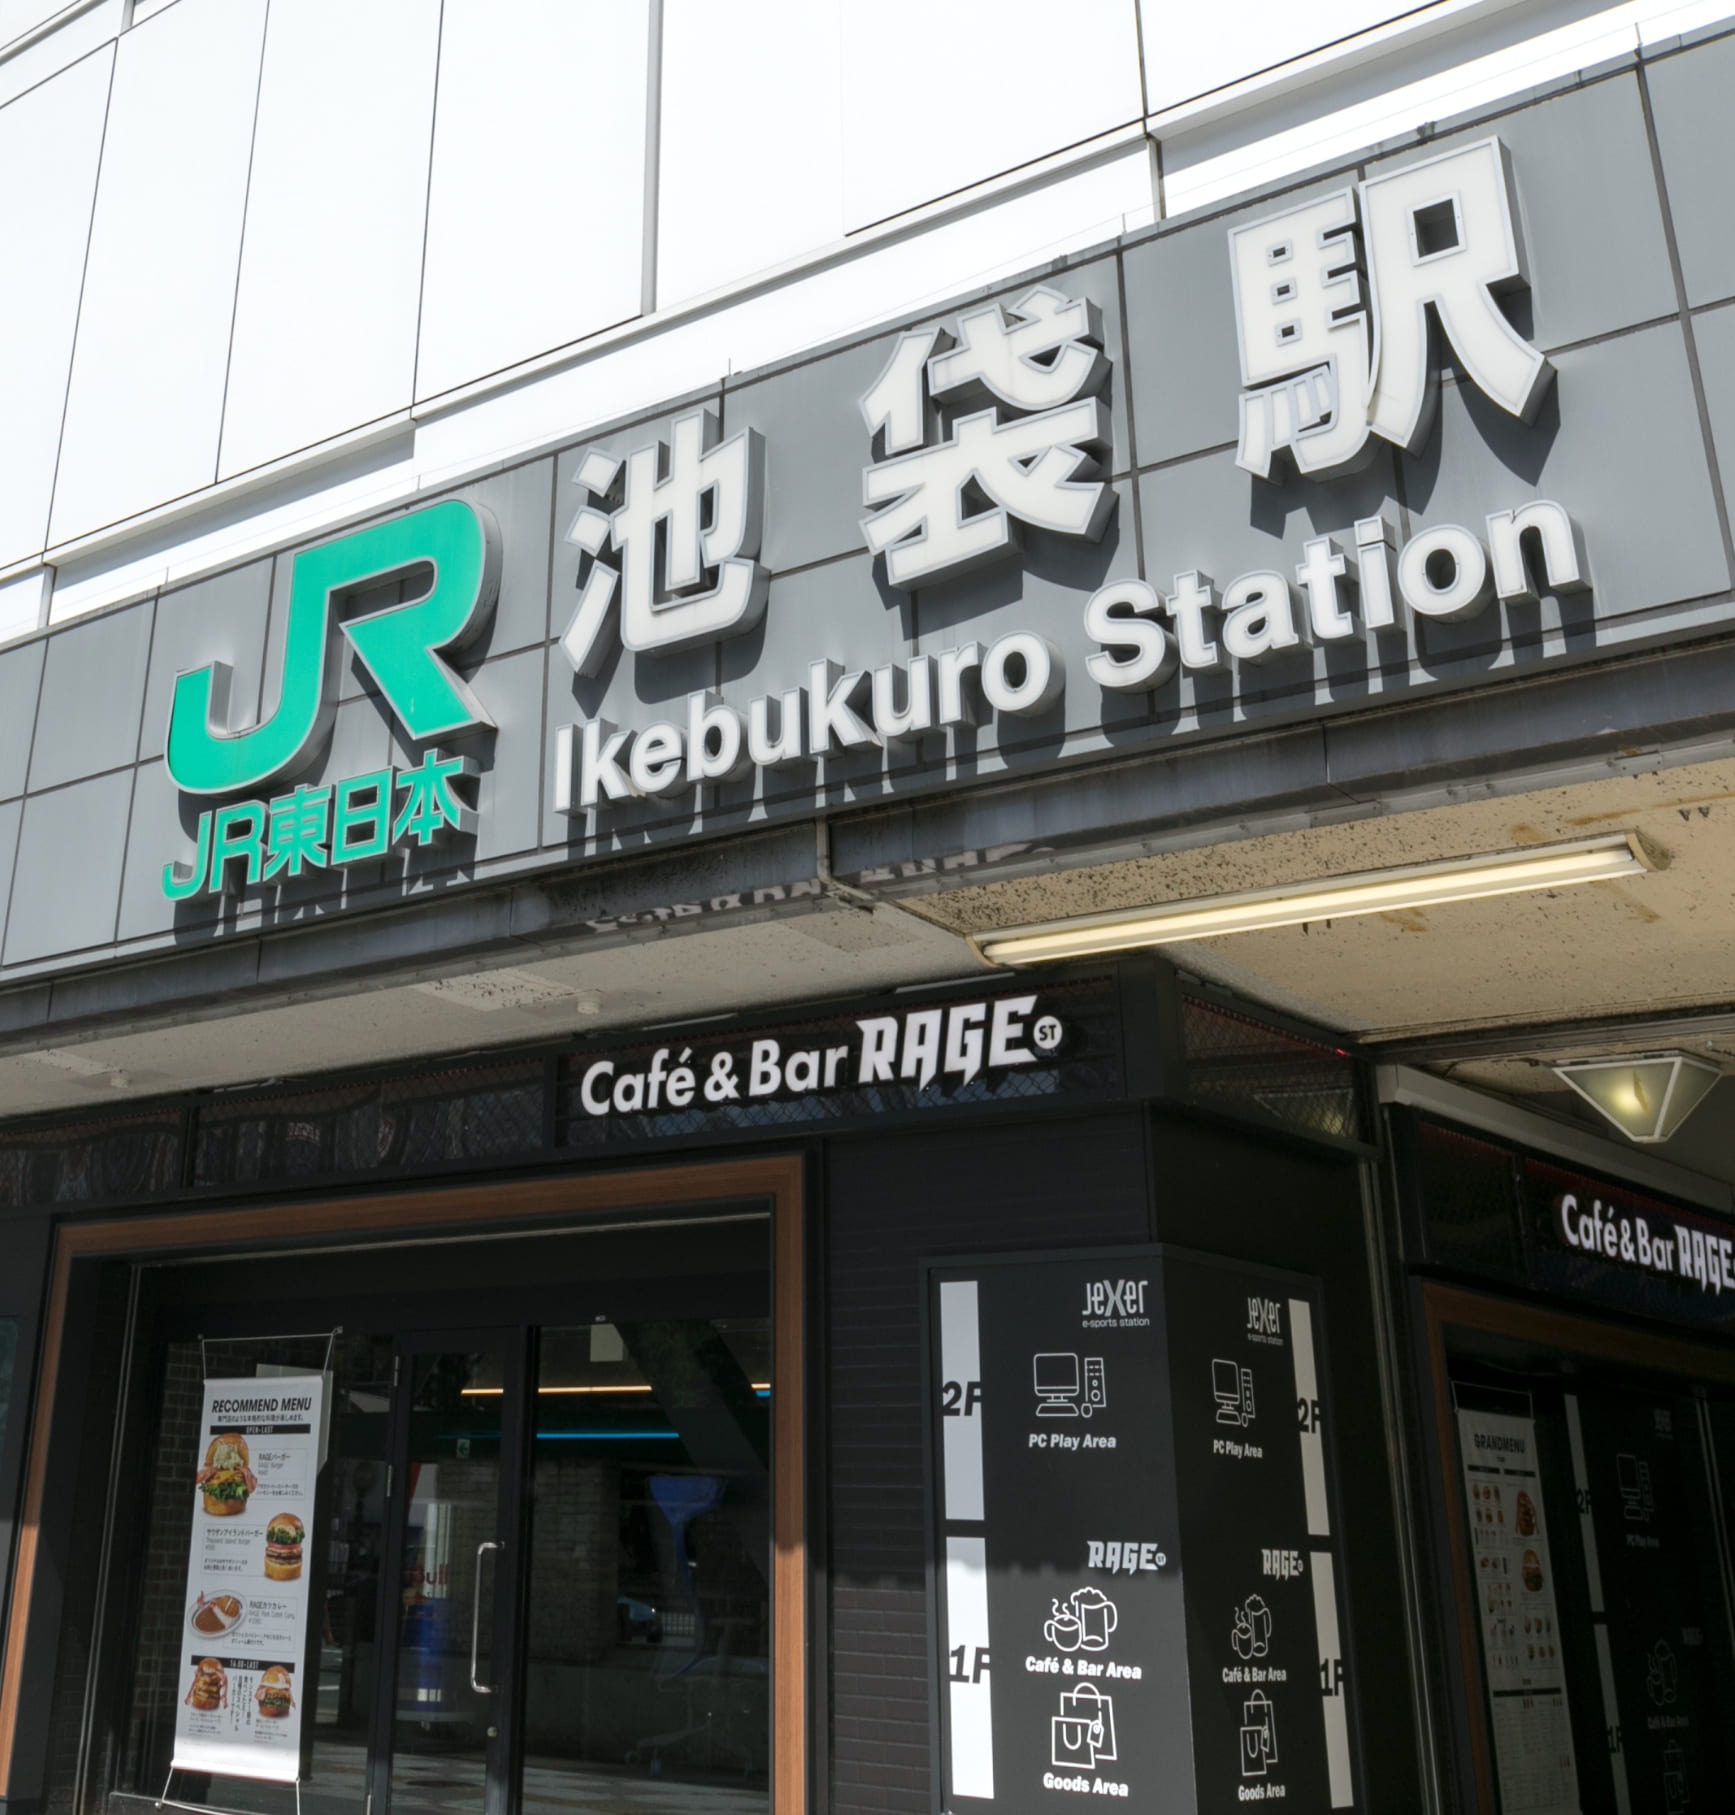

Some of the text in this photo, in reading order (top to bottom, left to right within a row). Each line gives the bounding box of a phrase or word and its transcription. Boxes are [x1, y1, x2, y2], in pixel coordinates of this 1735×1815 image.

[558, 135, 1552, 672] 池袋駅
[164, 499, 494, 795] JR
[553, 500, 1588, 814] Ikebukuro Station
[161, 749, 474, 901] JR東日本
[581, 1046, 696, 1117] Café
[703, 1050, 741, 1101] &
[748, 1038, 850, 1097] Bar
[855, 994, 1038, 1092] RAGE
[1561, 1193, 1735, 1296] Café & Bar RAGE
[1081, 1317, 1151, 1328] e-sports station
[212, 1397, 312, 1413] RECOMMEND MENU
[1028, 1433, 1117, 1451] PC Play Area
[1213, 1439, 1264, 1459] PC Play Area
[1086, 1540, 1159, 1576] RAGE
[1261, 1548, 1300, 1581] RAGE
[1025, 1655, 1142, 1680] Café & Bar Area
[1222, 1667, 1242, 1683] Café
[1252, 1667, 1267, 1682] Bar
[1267, 1666, 1287, 1682] Area
[1043, 1771, 1129, 1797] Goods Area
[1238, 1783, 1286, 1802] Goods Area
